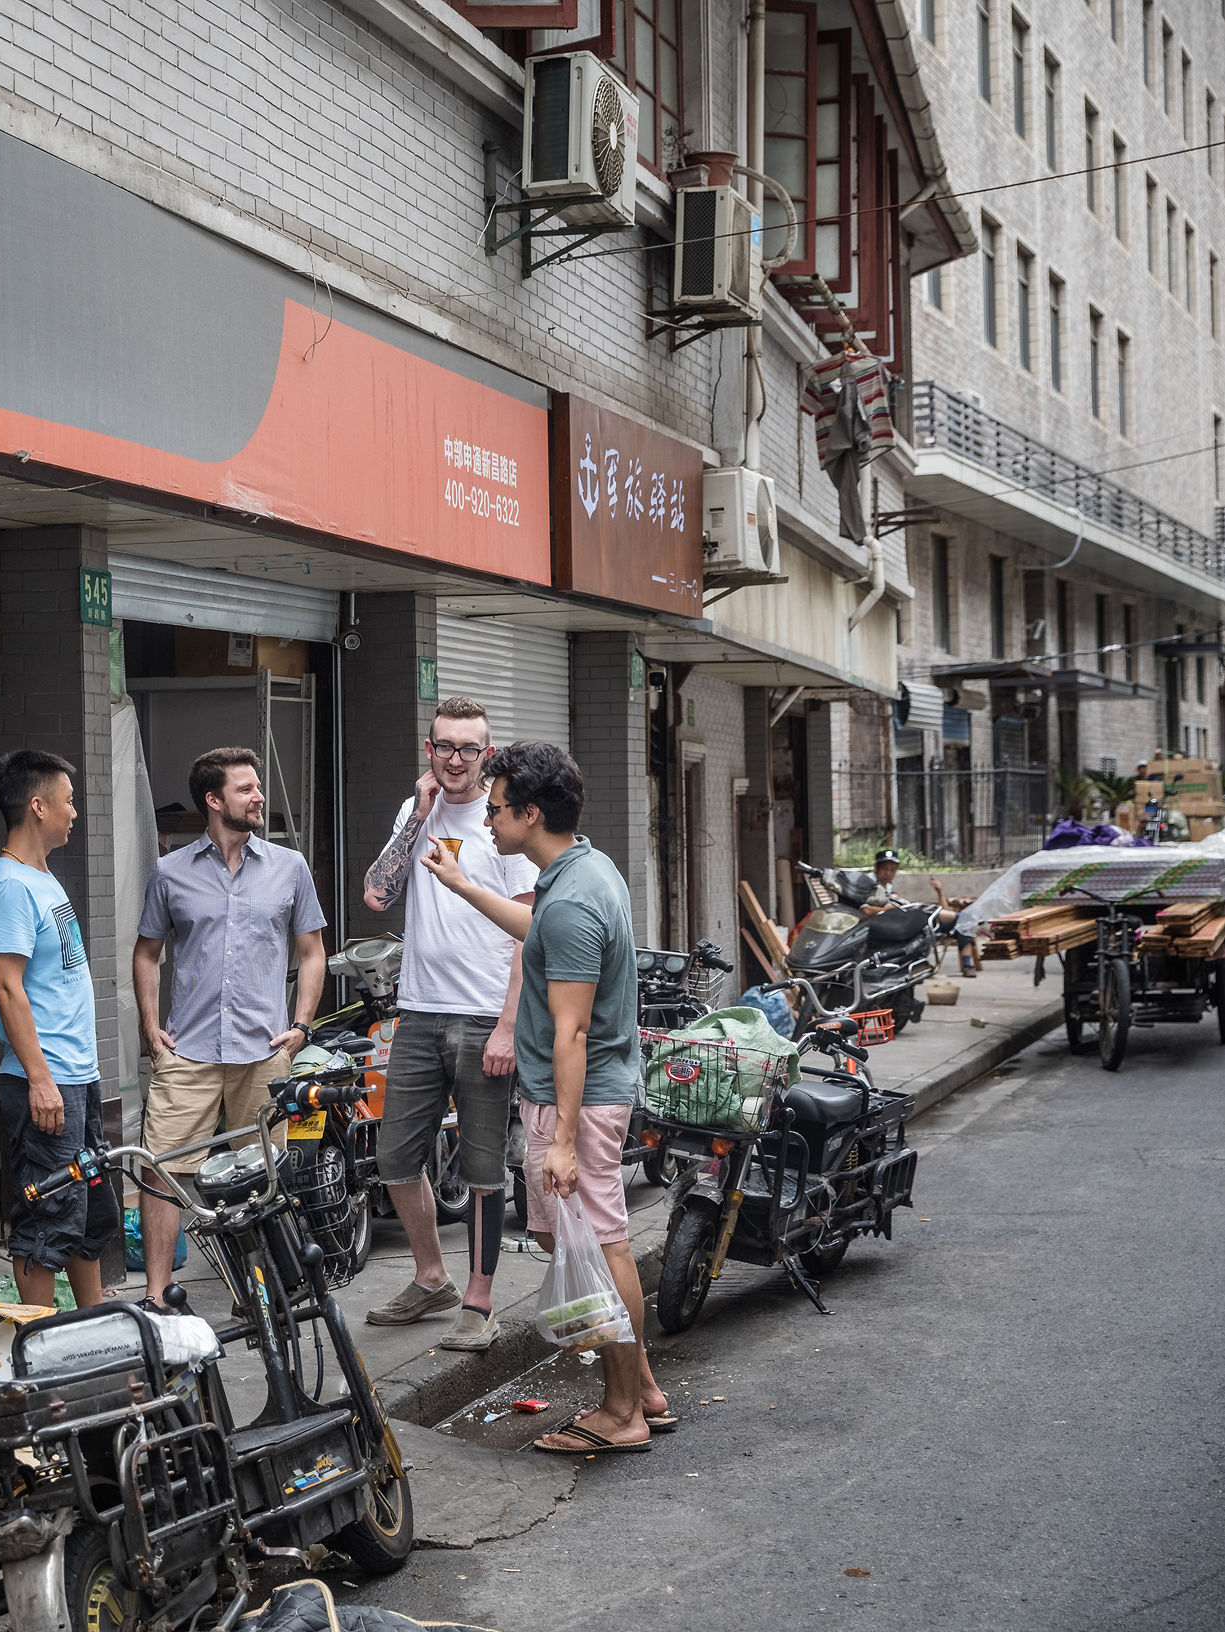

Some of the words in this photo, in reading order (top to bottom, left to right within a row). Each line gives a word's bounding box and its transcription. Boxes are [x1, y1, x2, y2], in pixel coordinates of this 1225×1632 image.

[444, 434, 518, 489] 中部申通新昌路店
[444, 478, 520, 527] 400-920-6322
[604, 448, 686, 533] 军旅驿站
[84, 574, 108, 607] 545
[61, 1344, 131, 1363] www.sf-express.com
